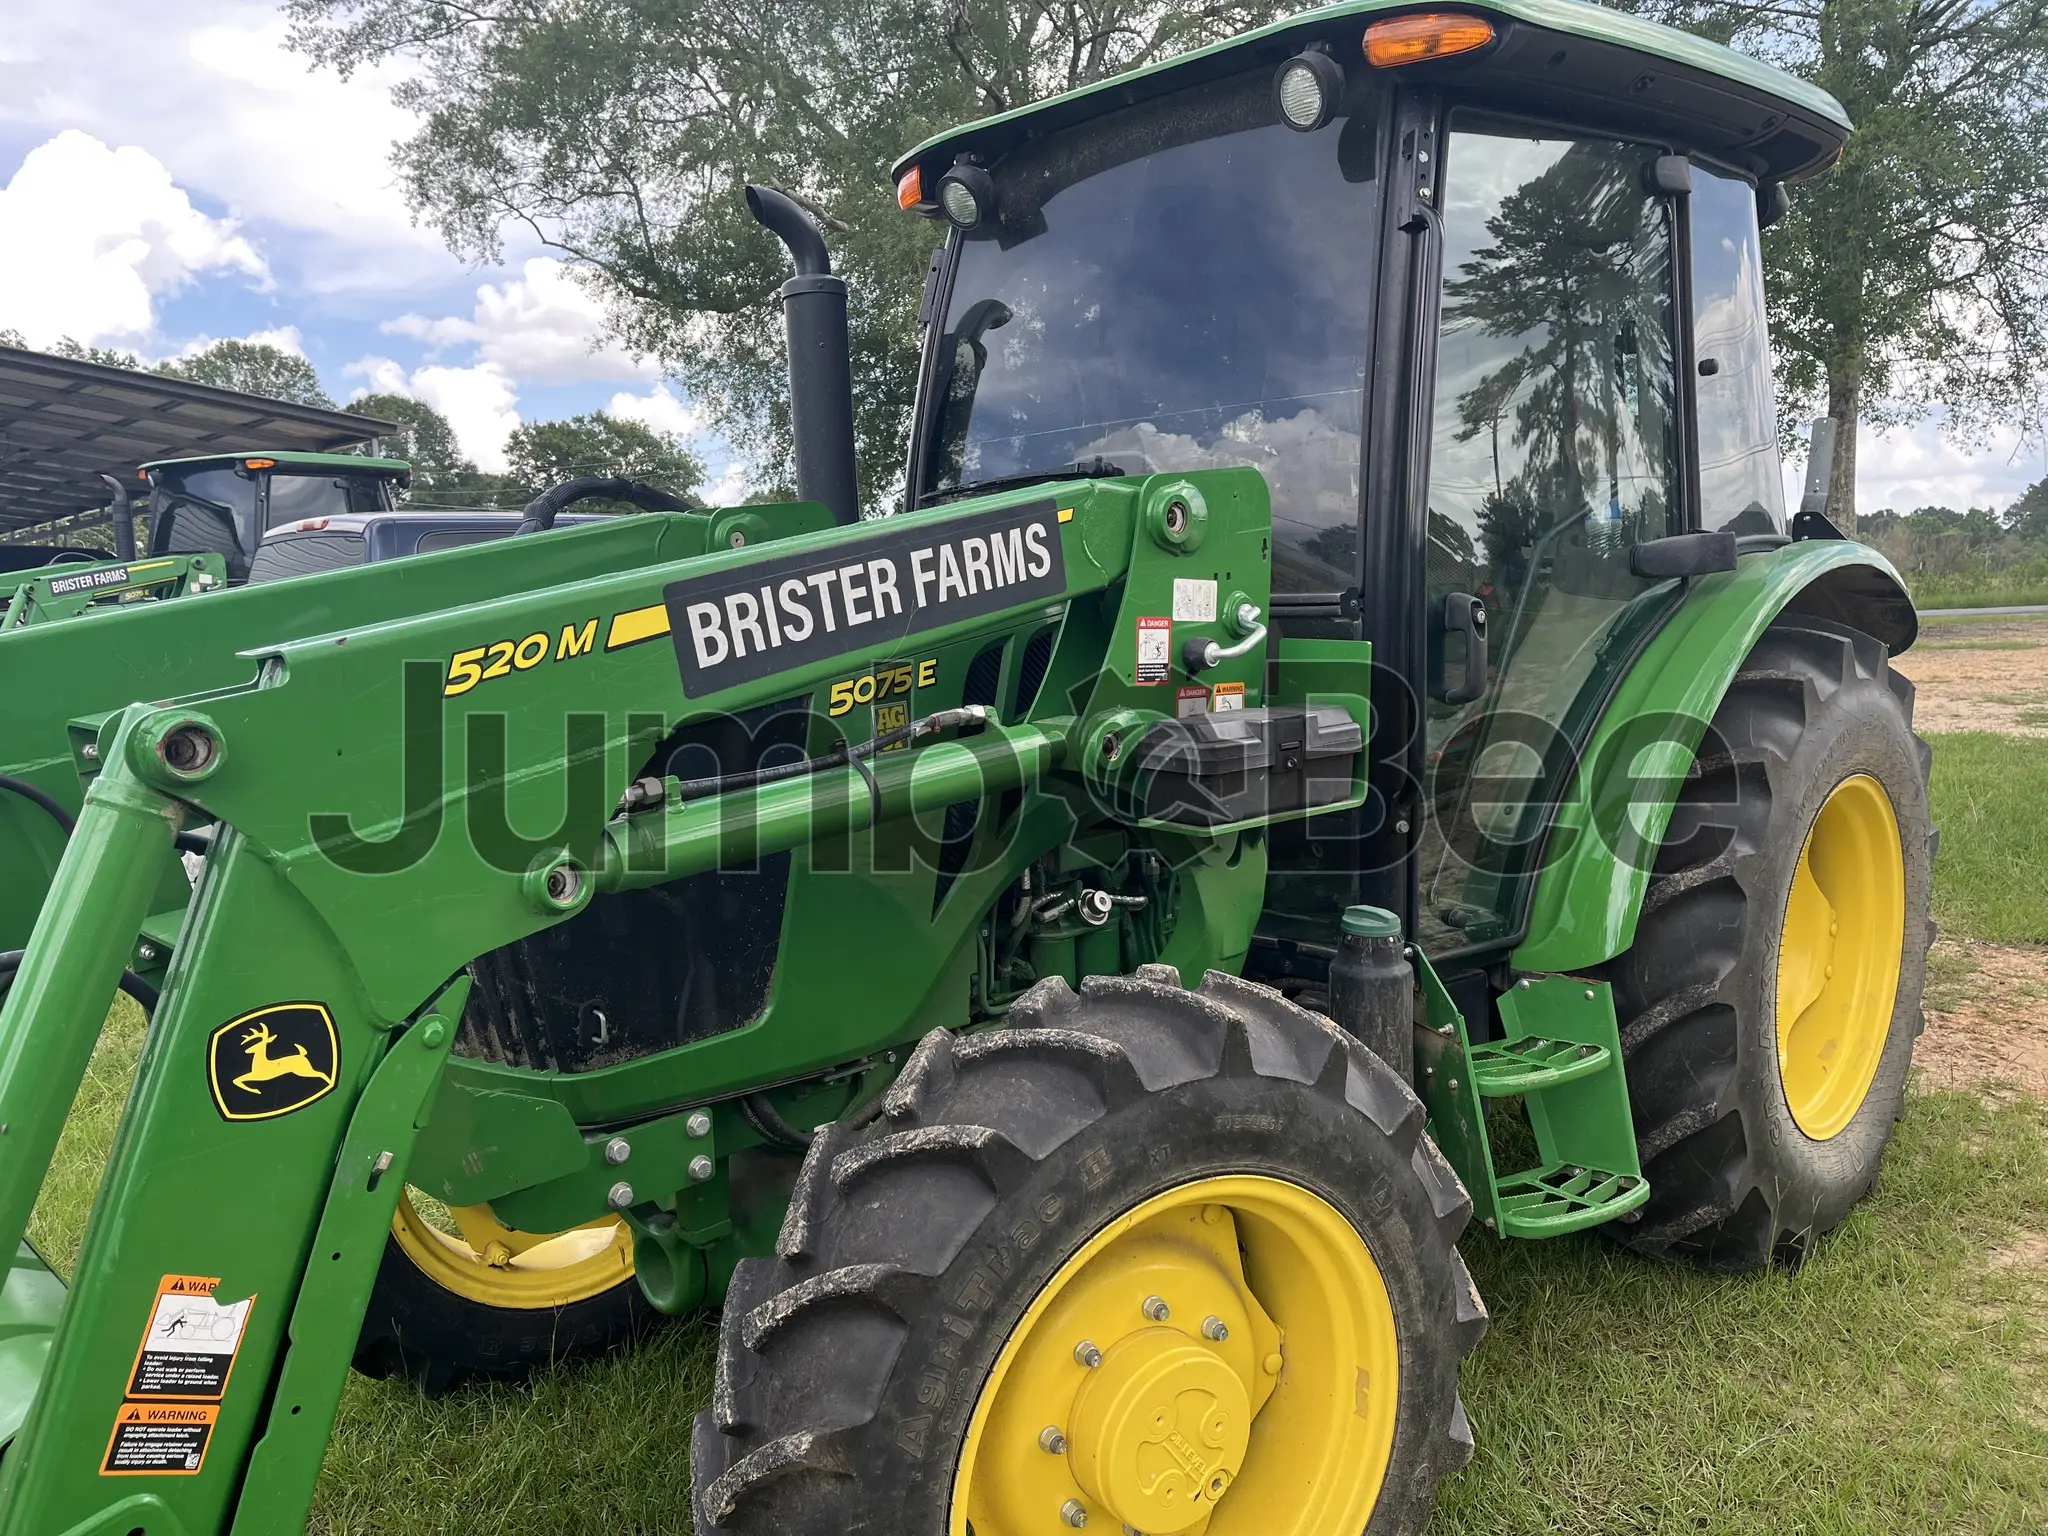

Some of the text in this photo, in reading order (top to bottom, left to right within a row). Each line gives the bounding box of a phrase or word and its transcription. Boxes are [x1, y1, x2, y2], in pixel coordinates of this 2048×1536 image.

[51, 568, 127, 593] BRISTER FARMS
[686, 522, 1053, 670] BRISTER FARMS
[444, 617, 600, 696] 520 M
[829, 658, 937, 716] 5075 E
[1186, 688, 1206, 696] DANGER
[878, 705, 905, 730] AG
[1758, 933, 1783, 1147] GALAXY
[1214, 1114, 1285, 1132] TUBELESS
[148, 1410, 207, 1420] WARNING
